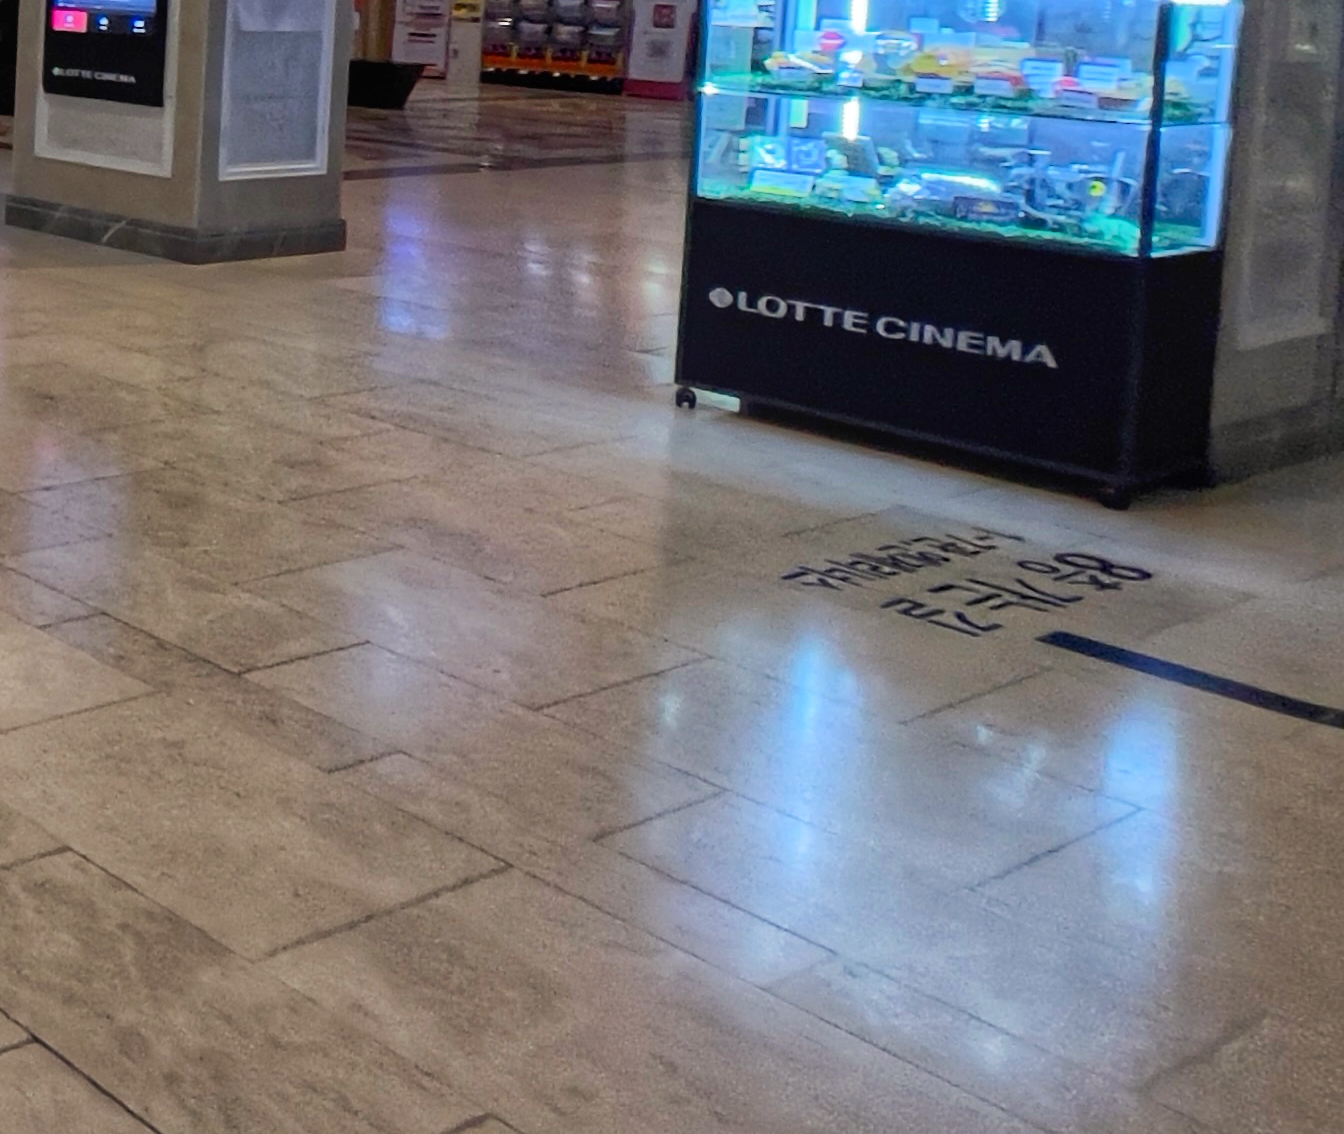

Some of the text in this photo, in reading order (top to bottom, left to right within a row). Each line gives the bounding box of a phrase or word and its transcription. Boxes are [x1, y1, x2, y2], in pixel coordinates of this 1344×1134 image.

[737, 289, 1059, 369] LOTTE CINEMA
[879, 552, 1153, 637] 8층 가는 길
